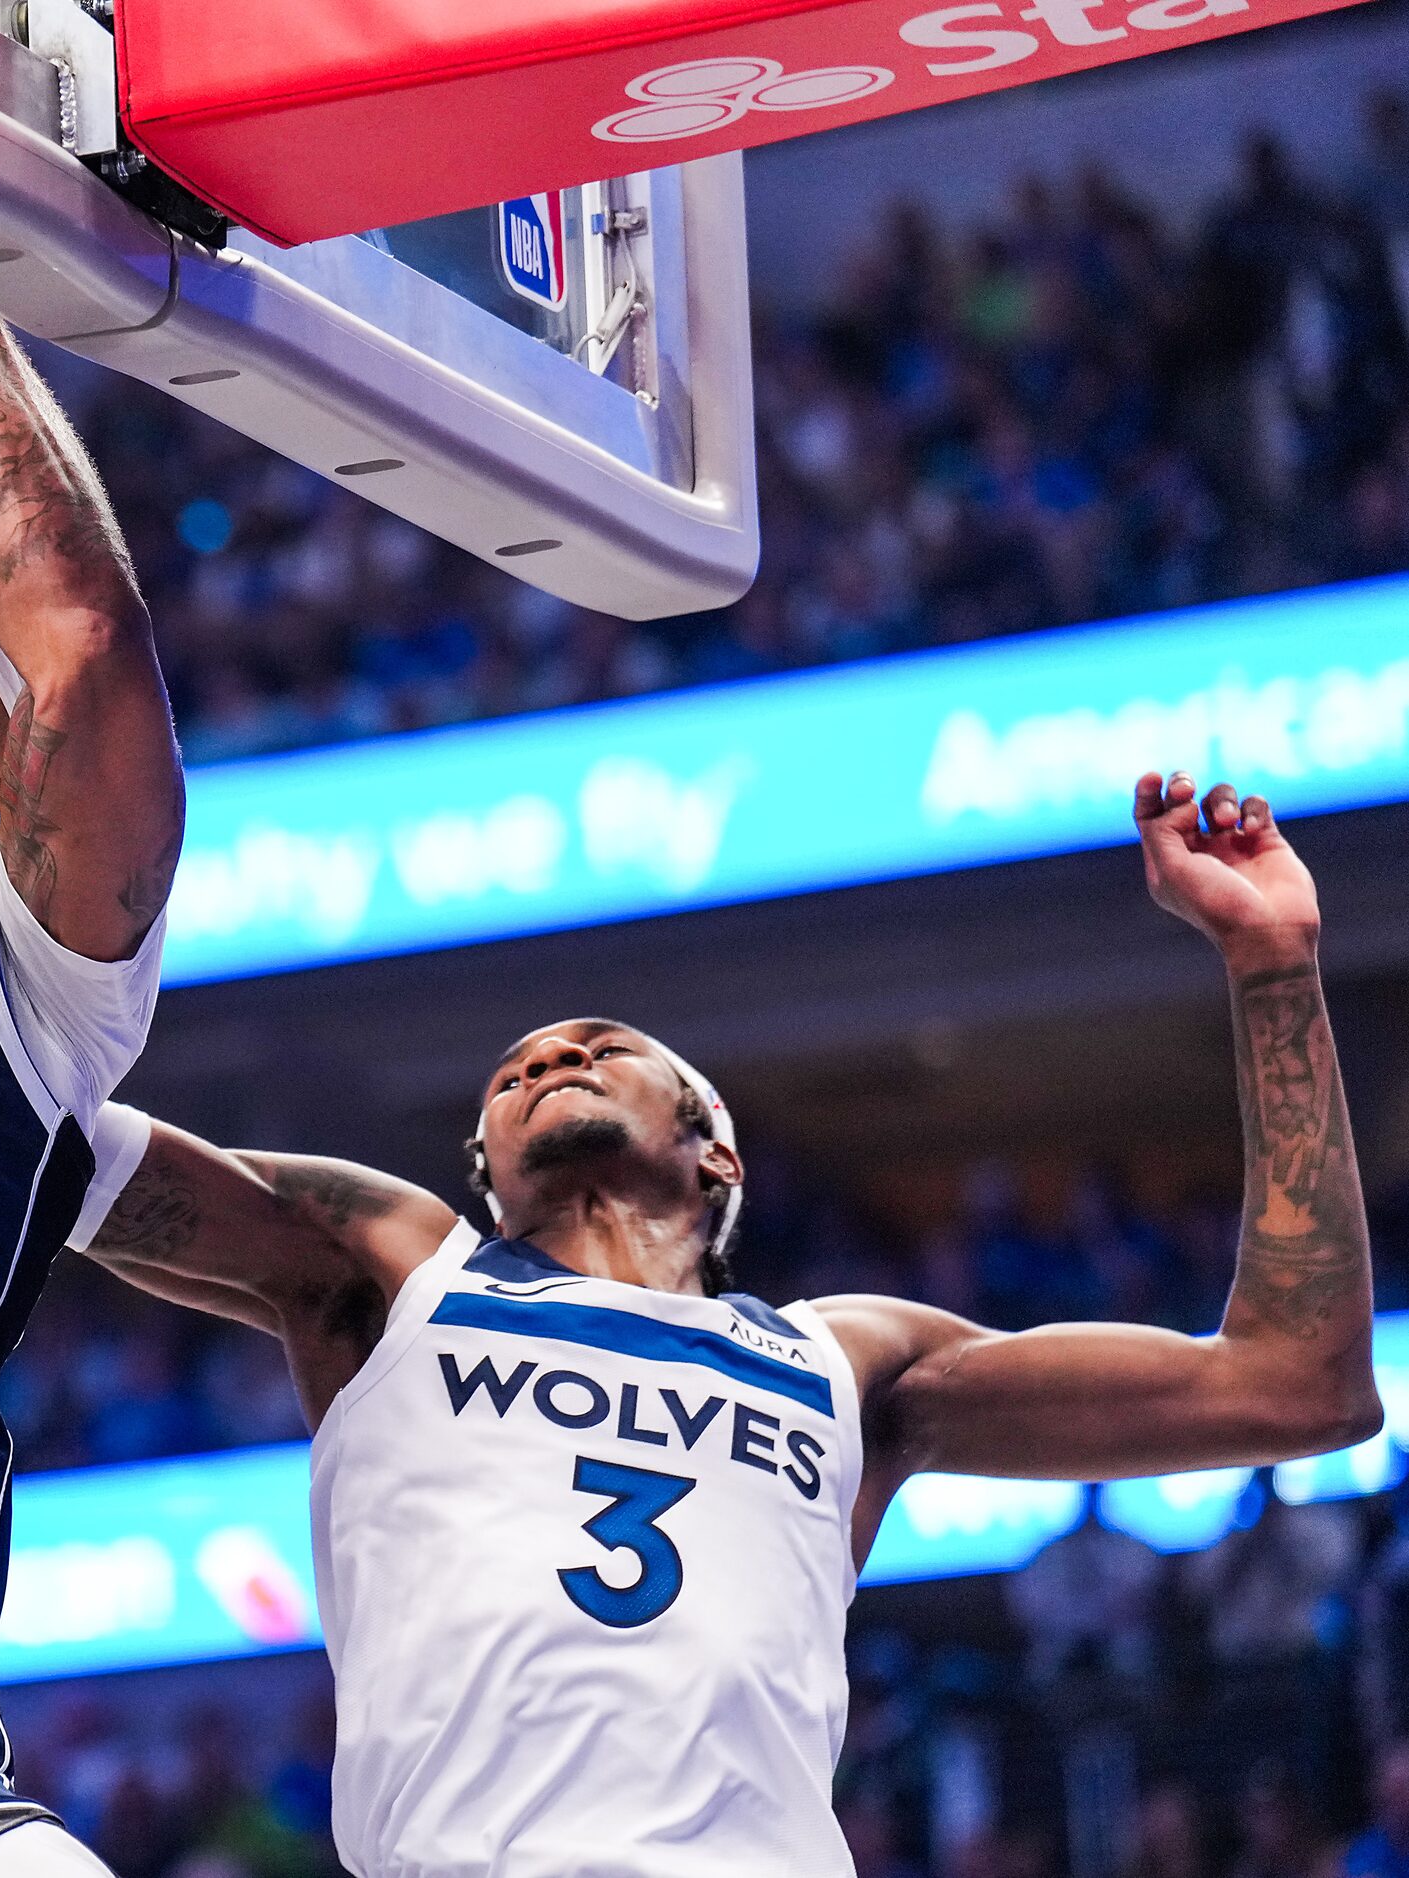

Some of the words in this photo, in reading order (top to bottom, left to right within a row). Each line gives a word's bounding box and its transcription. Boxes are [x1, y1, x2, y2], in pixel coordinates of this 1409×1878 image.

[510, 212, 544, 281] NBA
[438, 1354, 826, 1501] WOLVES
[557, 1455, 697, 1629] 3
